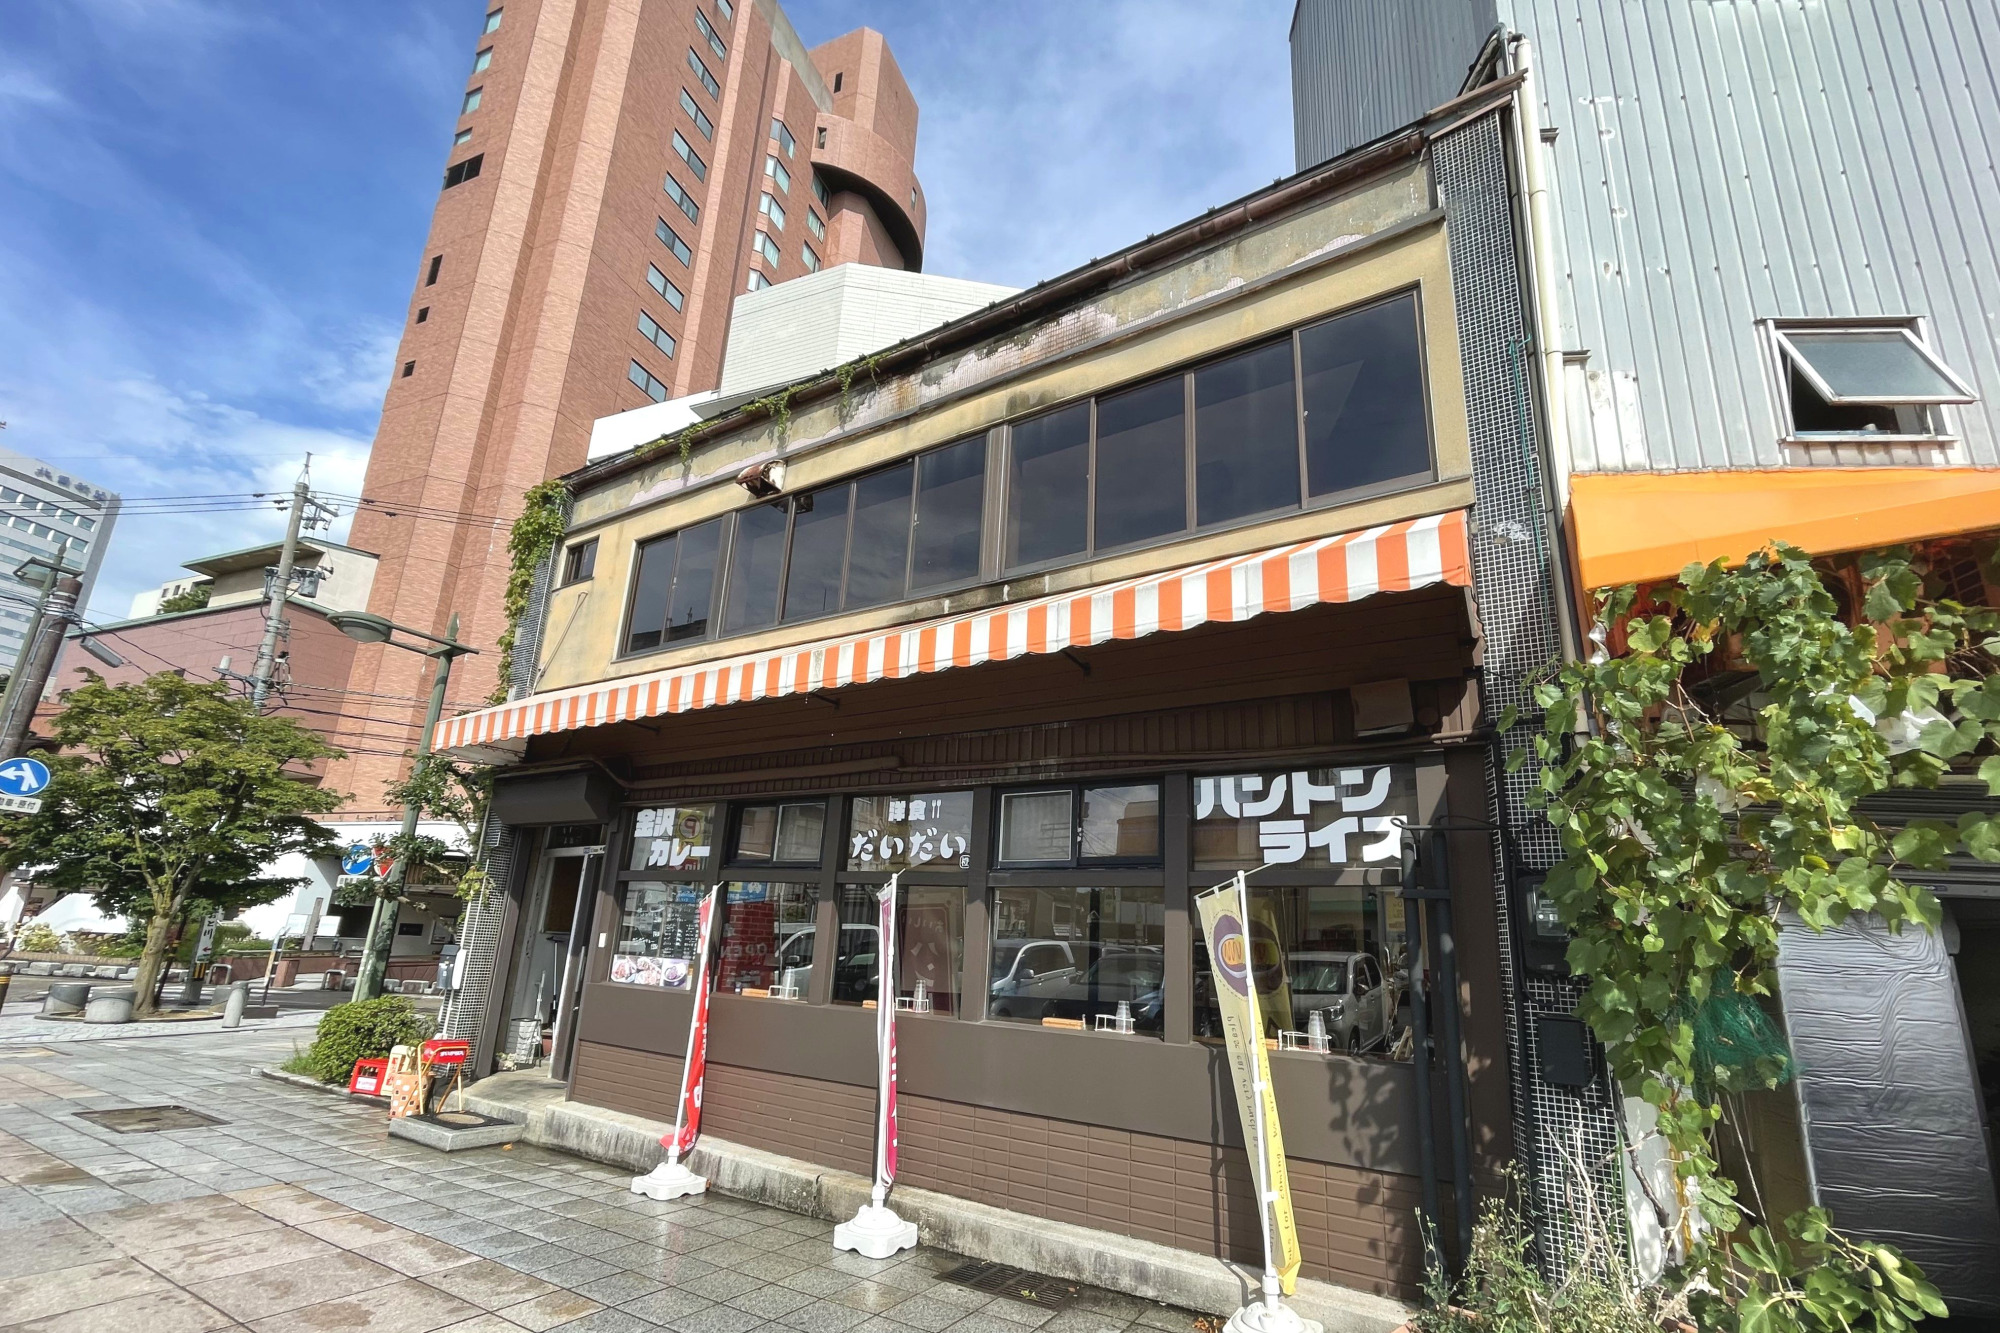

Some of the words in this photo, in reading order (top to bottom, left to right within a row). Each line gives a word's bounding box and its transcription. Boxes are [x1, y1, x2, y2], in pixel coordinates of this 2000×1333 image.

[1196, 766, 1392, 821] ハントン
[634, 808, 676, 838] 金沢
[888, 800, 927, 822] 洋食
[648, 838, 711, 867] カレー
[851, 826, 967, 862] だいだい
[1258, 815, 1408, 864] ライス
